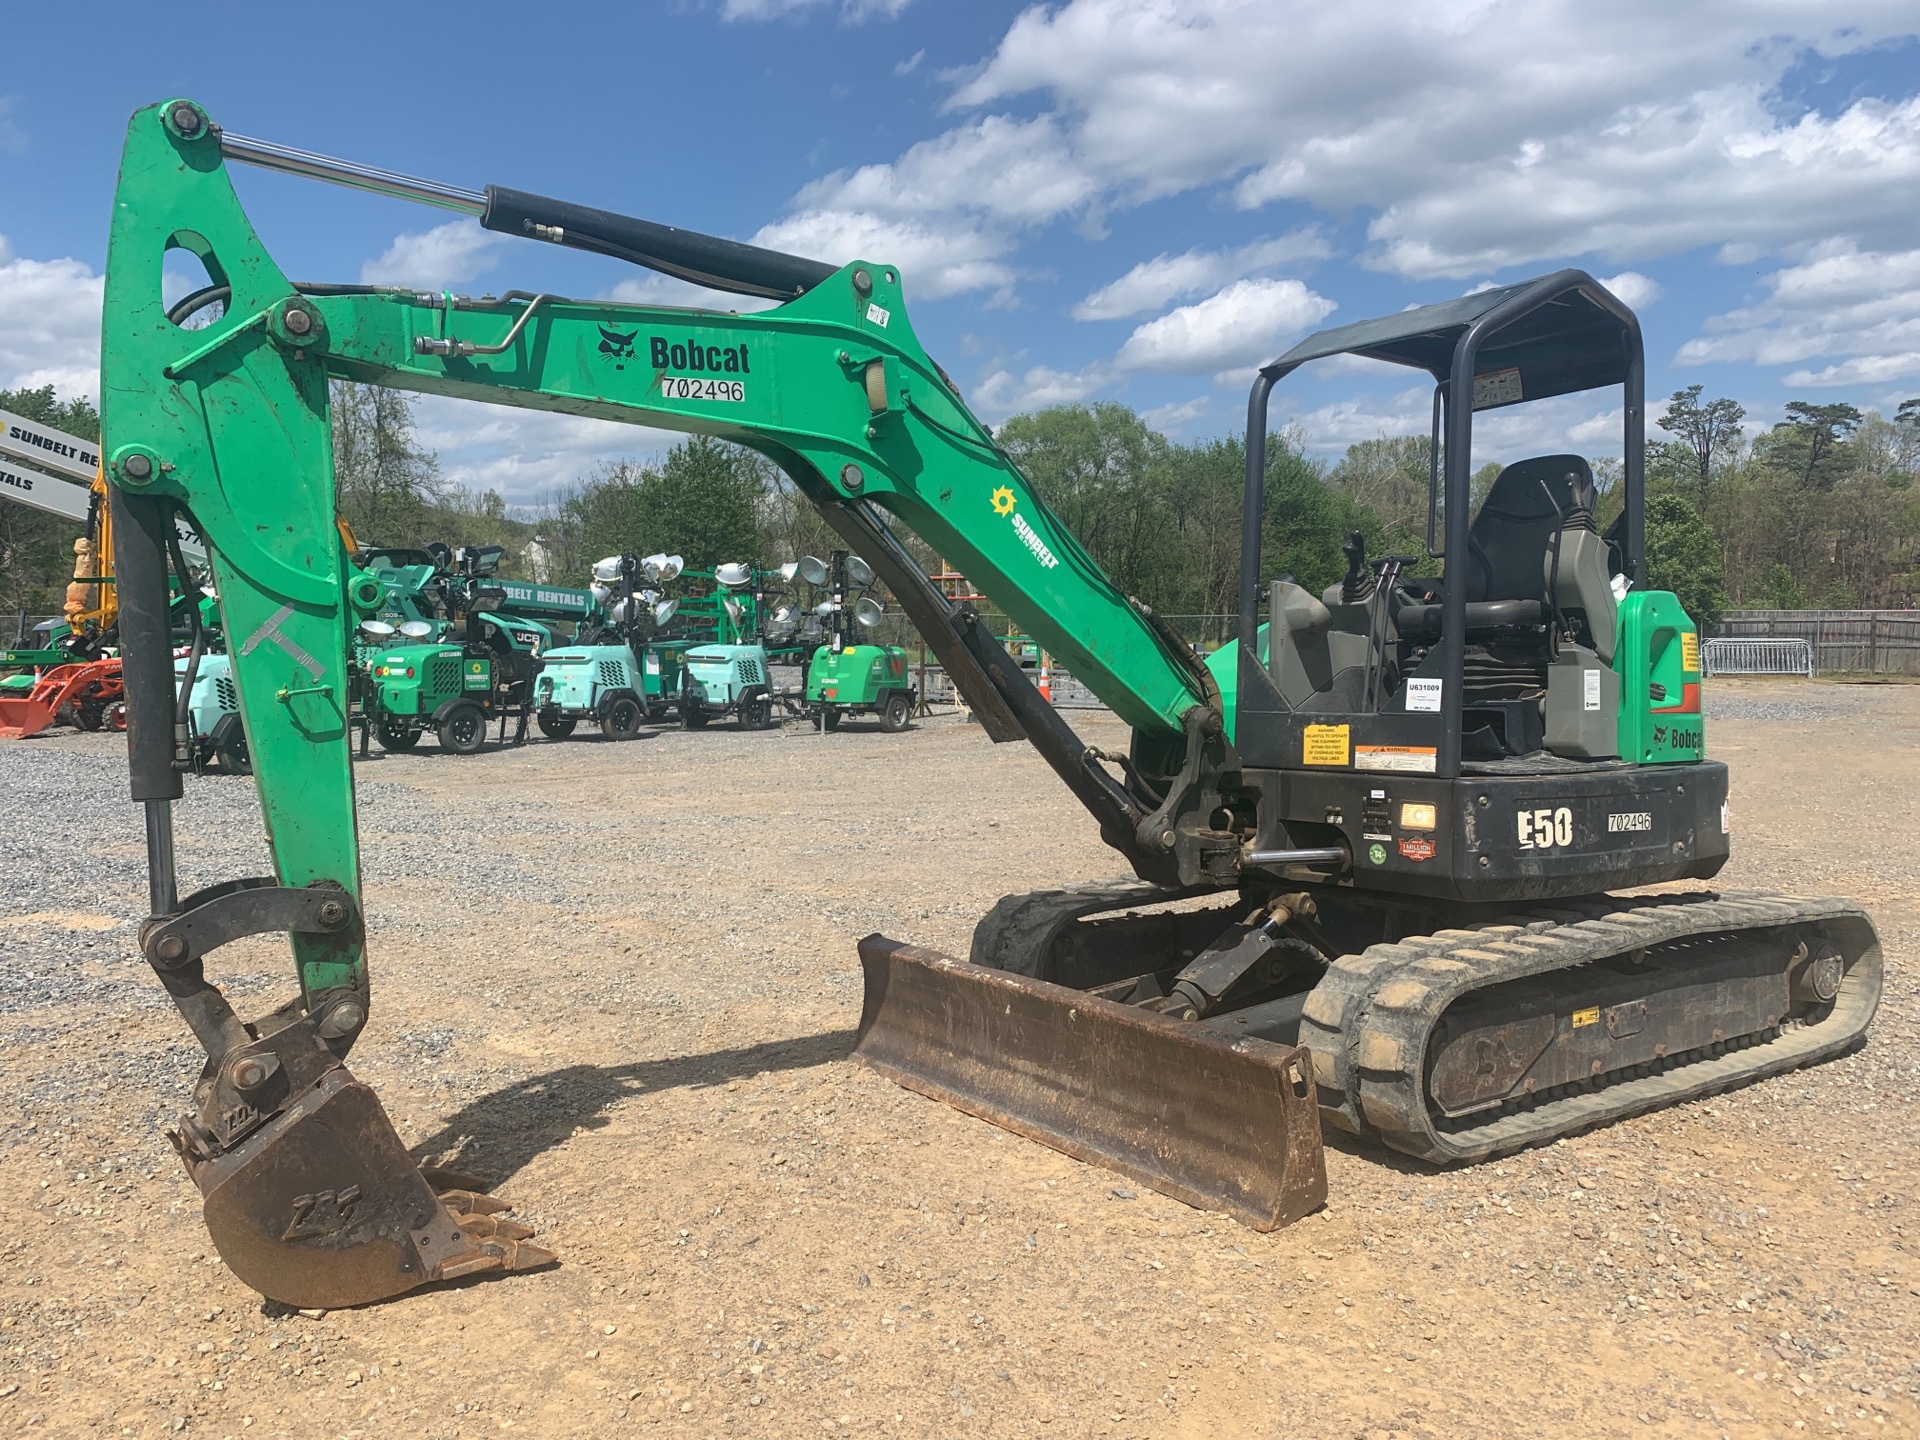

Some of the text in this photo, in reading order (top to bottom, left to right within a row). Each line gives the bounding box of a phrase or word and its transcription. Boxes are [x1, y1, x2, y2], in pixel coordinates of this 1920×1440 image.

[650, 336, 750, 374] Bobcat
[662, 377, 743, 401] 702496
[9, 426, 100, 468] SUNBELT RE
[1011, 513, 1059, 569] SUNBELT
[1013, 528, 1047, 567] RENTALS
[536, 590, 585, 606] RENTALS
[516, 632, 540, 643] JCB
[1409, 684, 1440, 692] U631009
[1517, 807, 1573, 850] E50
[1609, 813, 1651, 831] 702496
